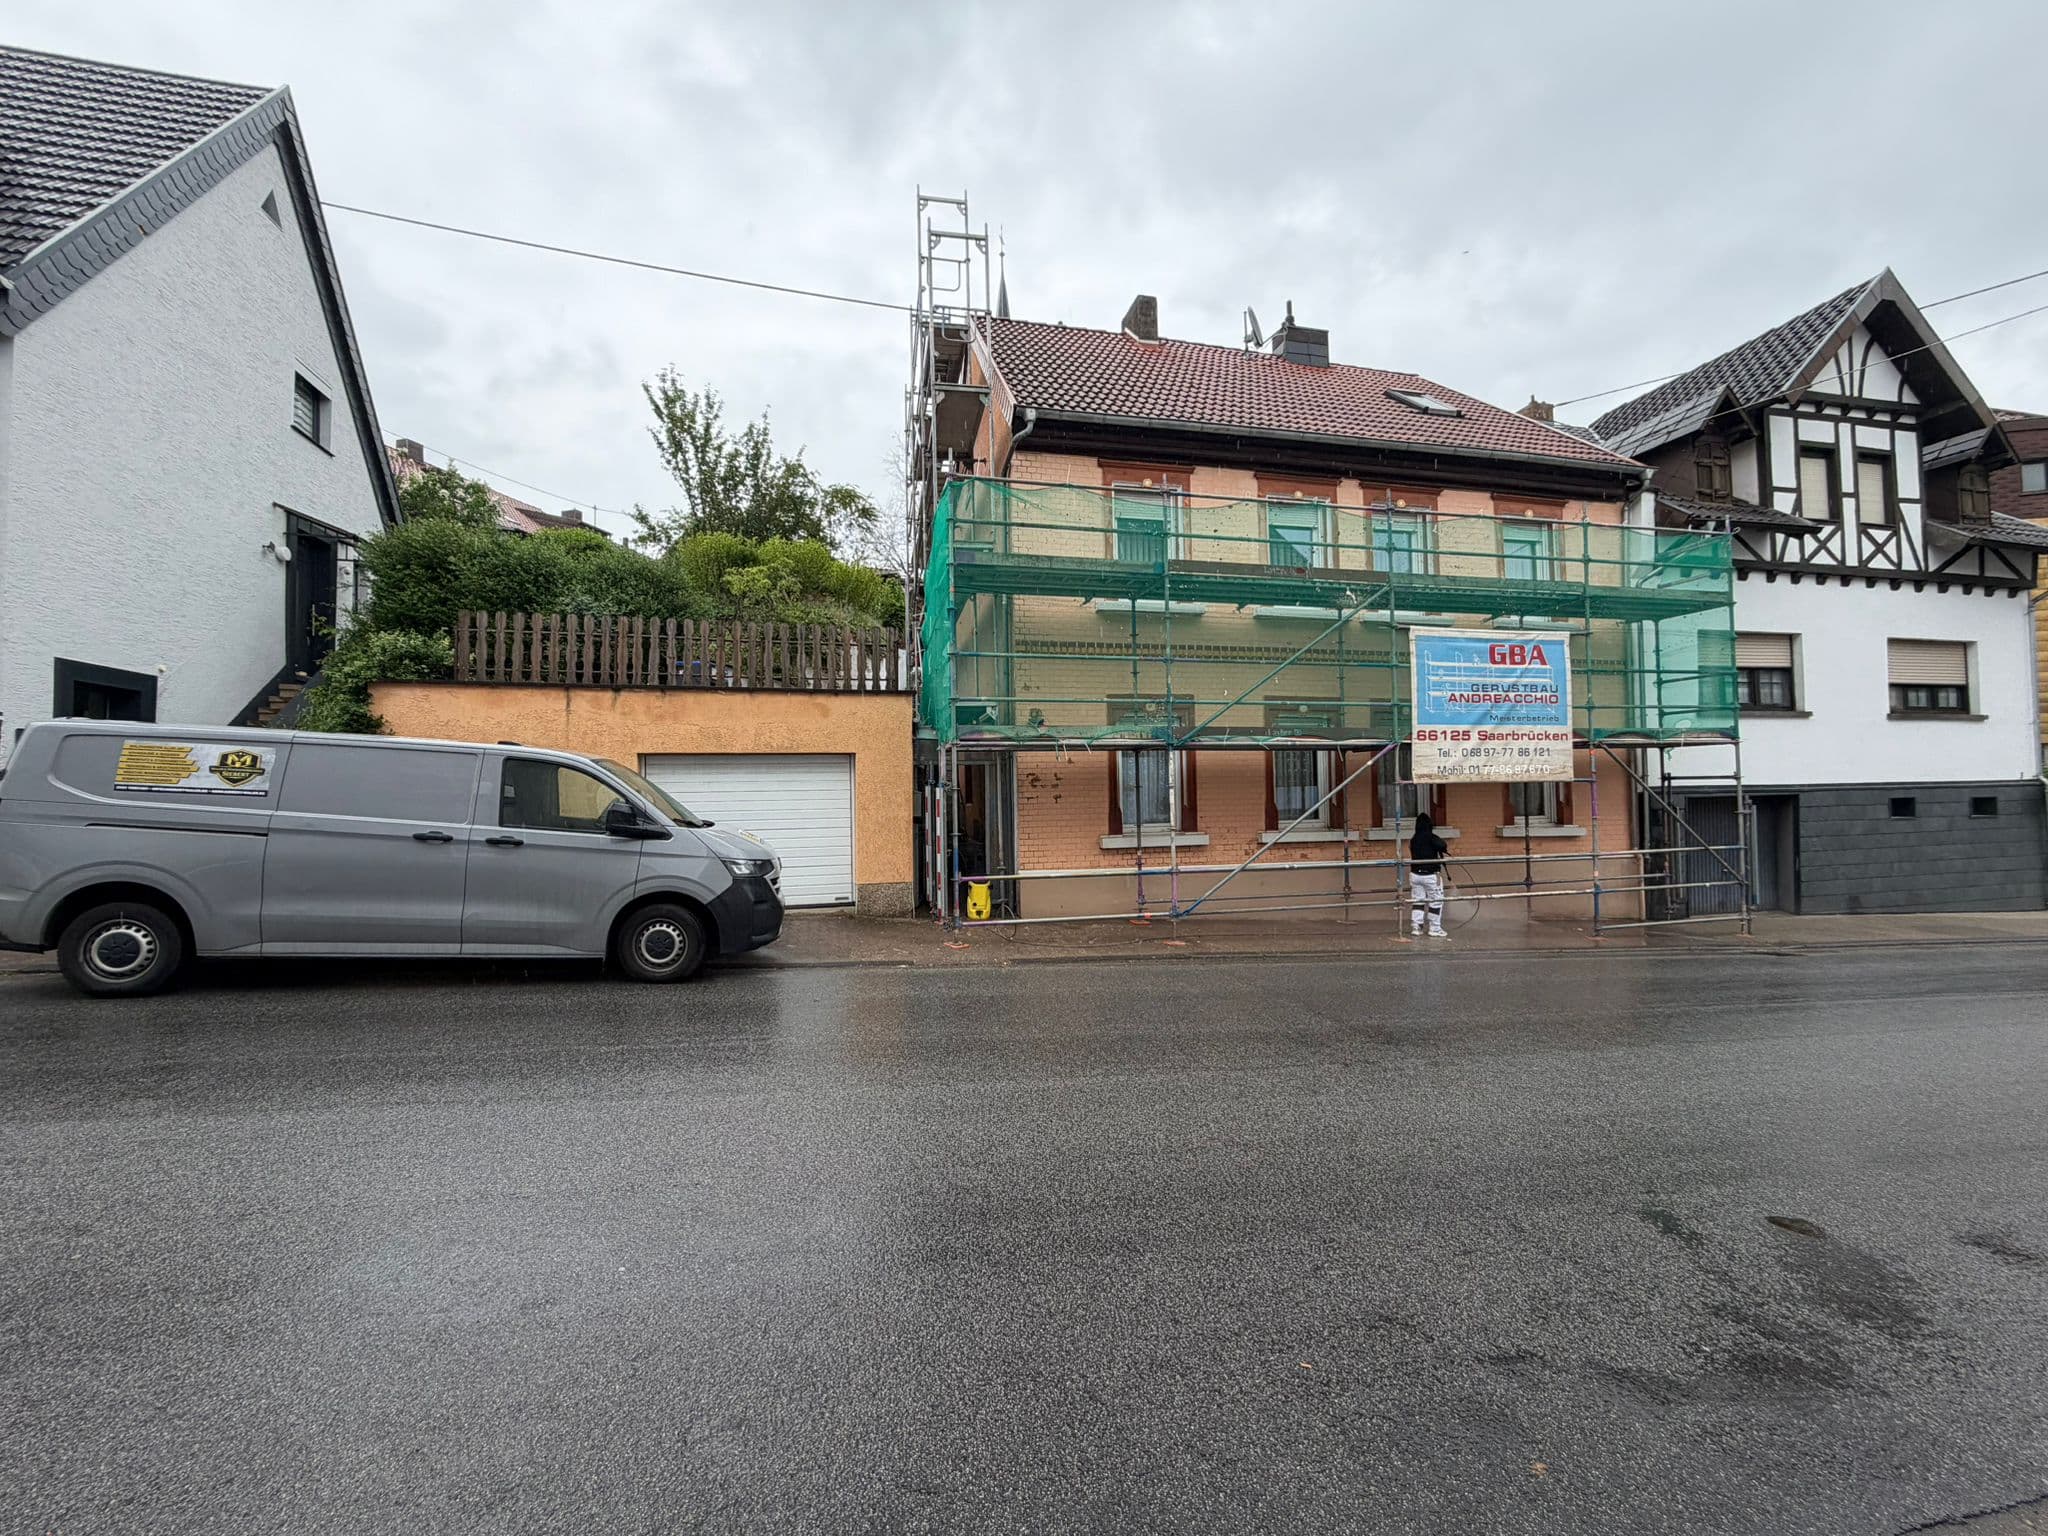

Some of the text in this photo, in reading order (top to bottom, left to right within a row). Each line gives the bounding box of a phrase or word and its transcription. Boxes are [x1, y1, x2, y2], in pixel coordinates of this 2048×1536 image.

[1488, 643, 1548, 666] GBA
[1447, 694, 1559, 704] ANDREACCHIO
[1489, 714, 1560, 722] Meisterbetrieb
[1416, 730, 1569, 741] 66125 Saarbrücken
[1437, 748, 1457, 758] Tel.:
